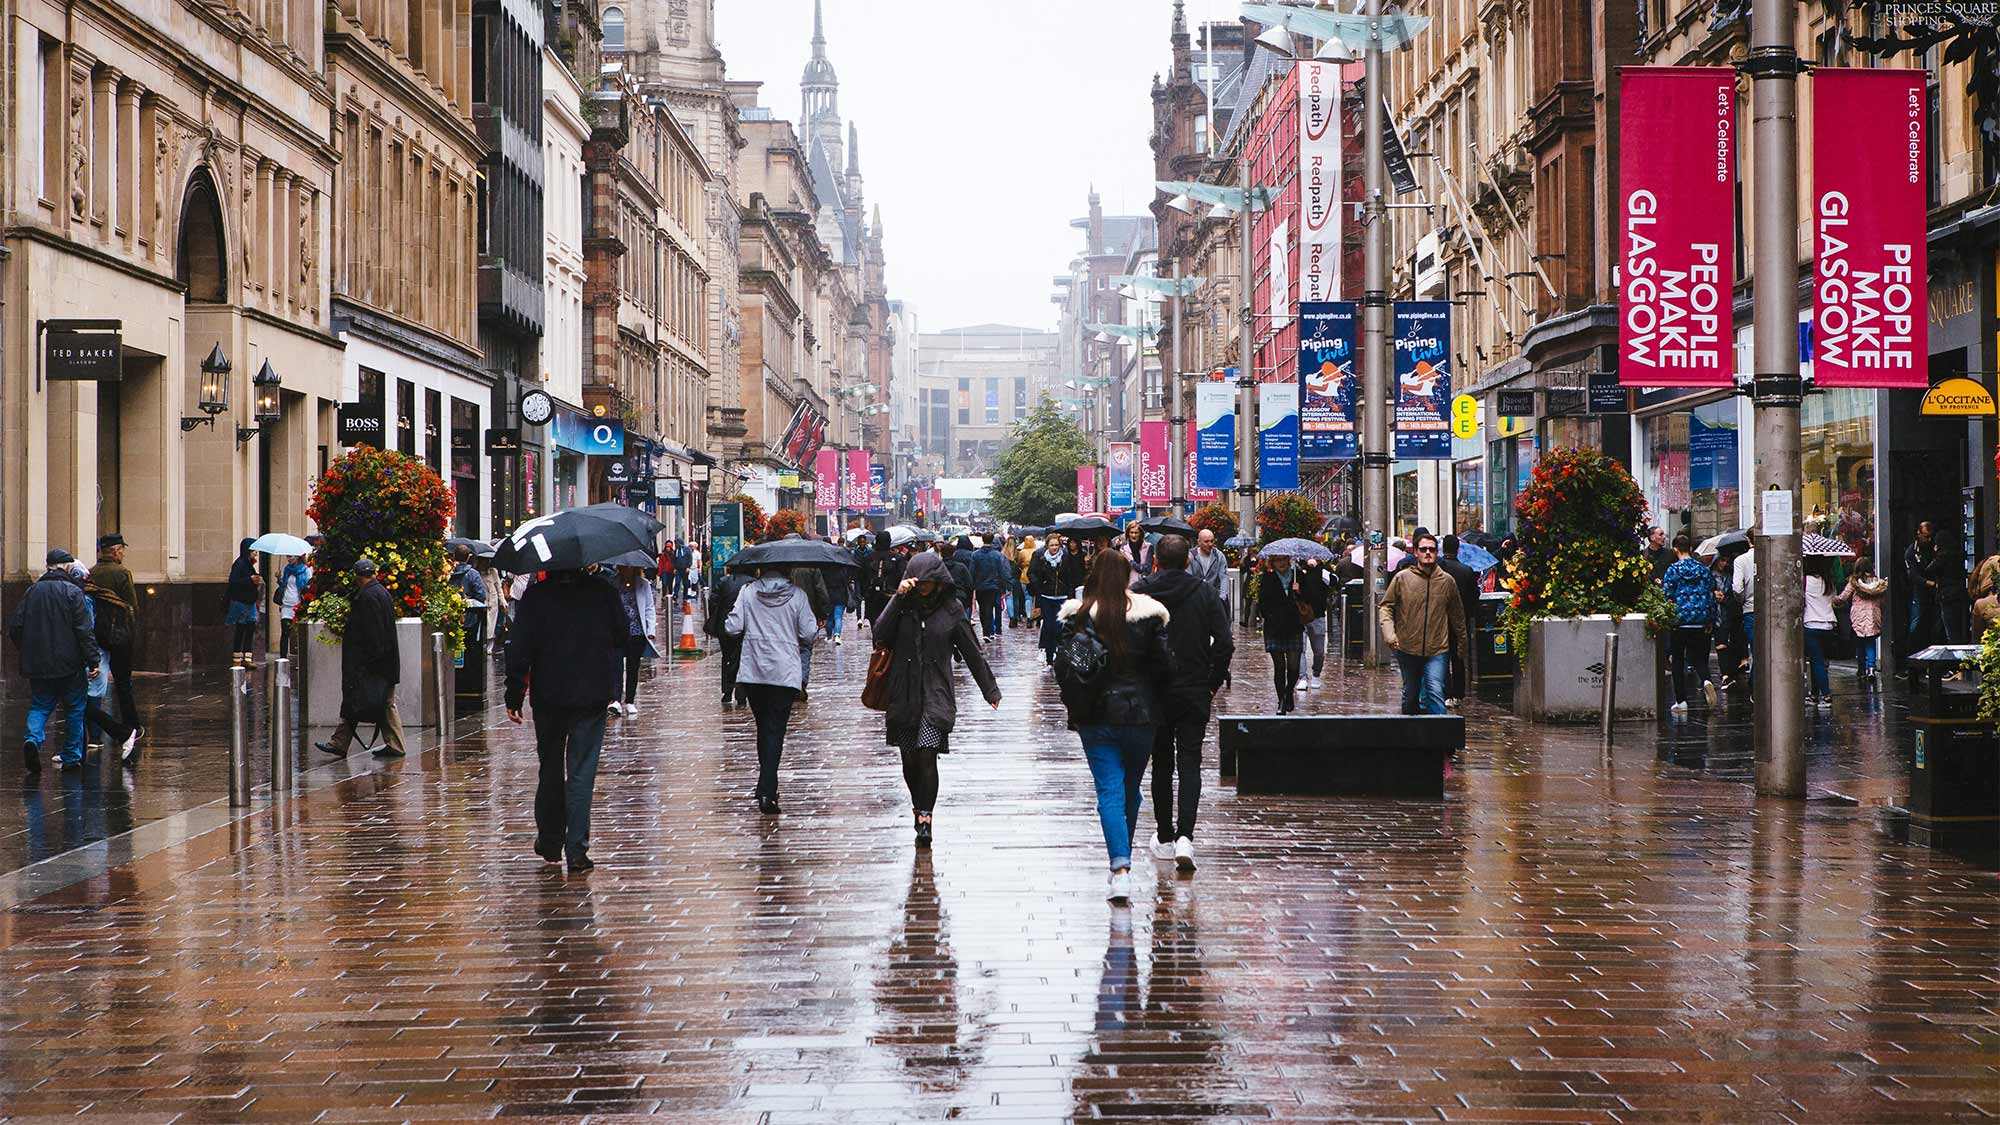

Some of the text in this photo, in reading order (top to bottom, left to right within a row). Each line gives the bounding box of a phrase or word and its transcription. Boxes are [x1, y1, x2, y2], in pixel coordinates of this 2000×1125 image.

[1886, 3, 1998, 15] PRINCES SQUARE
[1886, 16, 1946, 26] SHOPPING
[1309, 65, 1324, 128] Redpath
[1718, 86, 1729, 182] Let's Celebrate
[1909, 88, 1920, 183] Let's Celebrate
[1309, 156, 1324, 220] Redpath
[1627, 189, 1657, 368] GLASGOW
[1820, 191, 1849, 368] GLASGOW
[1659, 269, 1688, 368] MAKE
[1690, 243, 1719, 369] PEOPLE
[1851, 271, 1881, 369] MAKE
[1883, 244, 1912, 369] PEOPLE
[1930, 281, 1974, 328] SQUARE
[53, 349, 114, 358] TED BAKER
[1301, 337, 1343, 352] Piping
[1317, 340, 1349, 363] Live!
[1395, 337, 1437, 352] Piping
[1411, 340, 1444, 363] Live!
[346, 417, 379, 428] BOSS
[1928, 394, 1991, 405] L'OCCITANE
[1142, 451, 1150, 497] GLASGOW
[1150, 471, 1158, 497] MAKE
[1158, 464, 1166, 497] PEOPLE
